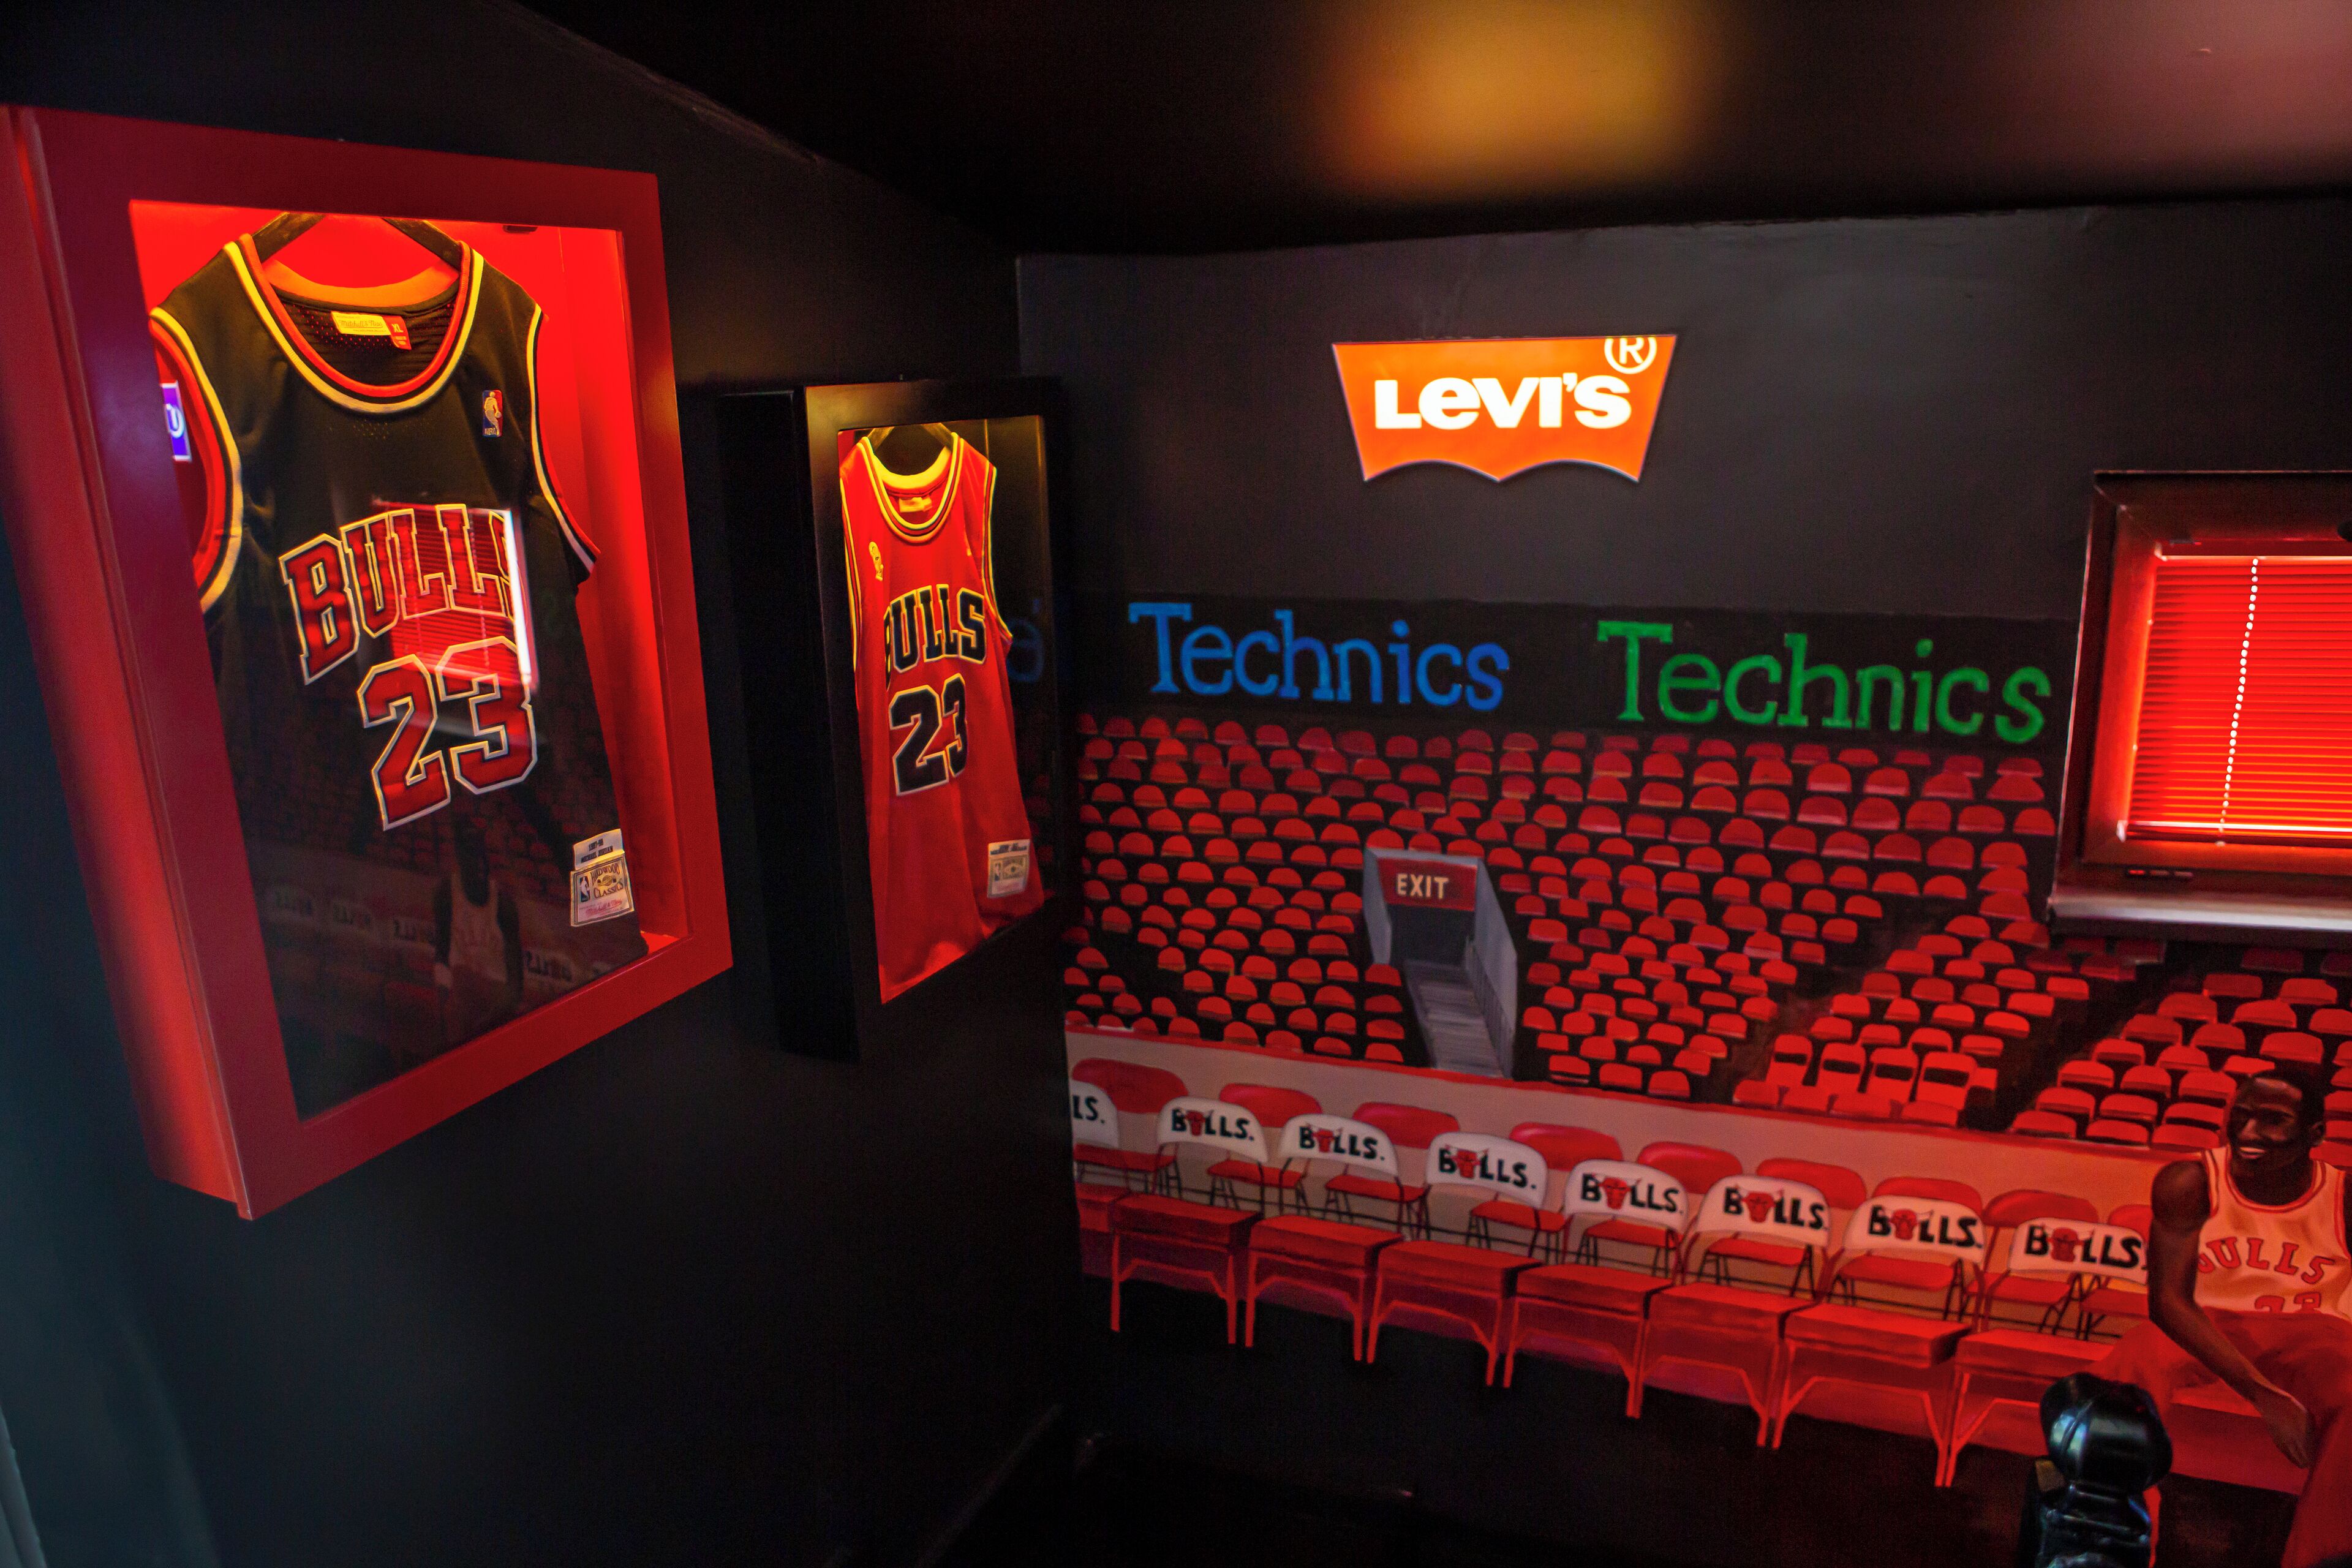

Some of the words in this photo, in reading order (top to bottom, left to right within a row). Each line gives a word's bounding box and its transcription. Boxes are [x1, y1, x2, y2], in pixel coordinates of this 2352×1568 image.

[391, 323, 404, 333] XL
[1128, 602, 1510, 711] Technics
[1597, 620, 2051, 743] Technics
[356, 635, 538, 831] 23
[888, 673, 968, 797] 23
[1396, 873, 1449, 899] EXIT
[1172, 1107, 1254, 1141] BLLS.
[1299, 1125, 1385, 1161] BLLS.
[1438, 1147, 1537, 1189] BLLS.
[1581, 1173, 1683, 1215] BLLS.
[1724, 1186, 1830, 1231] BLLS.
[1868, 1205, 1983, 1249] BLLS.
[2025, 1224, 2147, 1270] BLLS.
